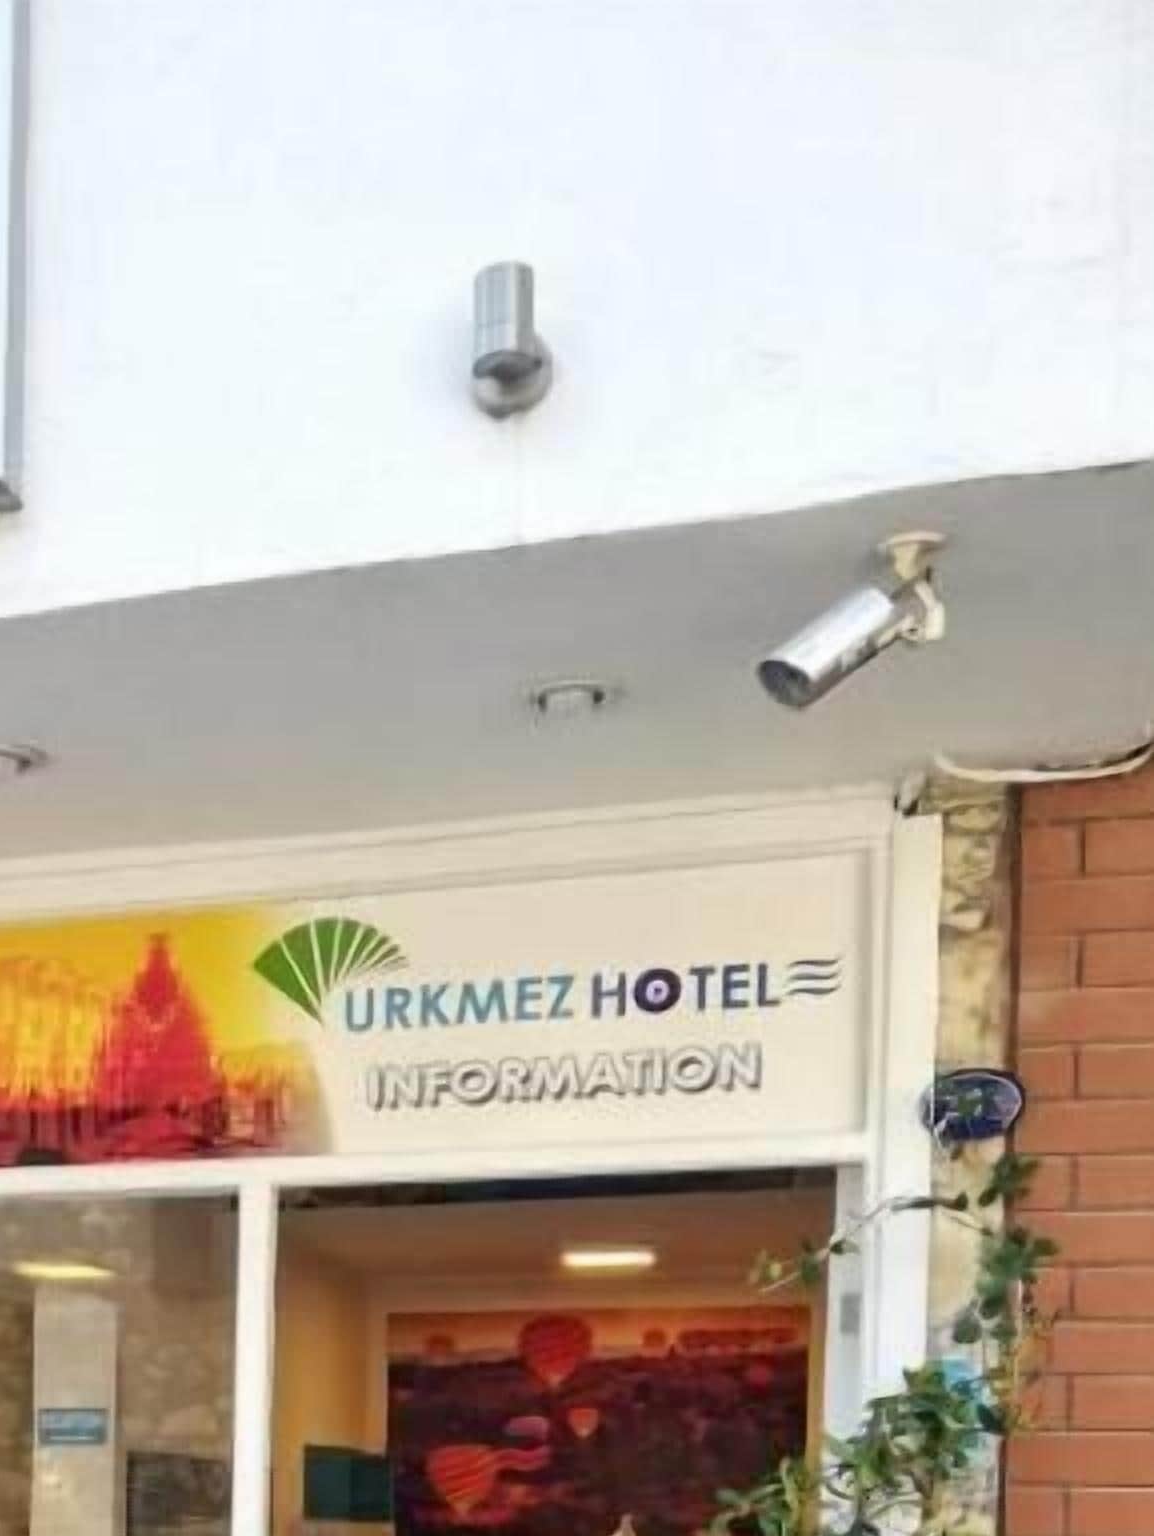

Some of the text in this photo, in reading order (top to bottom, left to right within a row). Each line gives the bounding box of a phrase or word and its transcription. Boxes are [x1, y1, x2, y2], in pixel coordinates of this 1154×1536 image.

[344, 962, 783, 1034] URKMEZ HOTEL
[366, 1042, 763, 1111] INFORMATION
